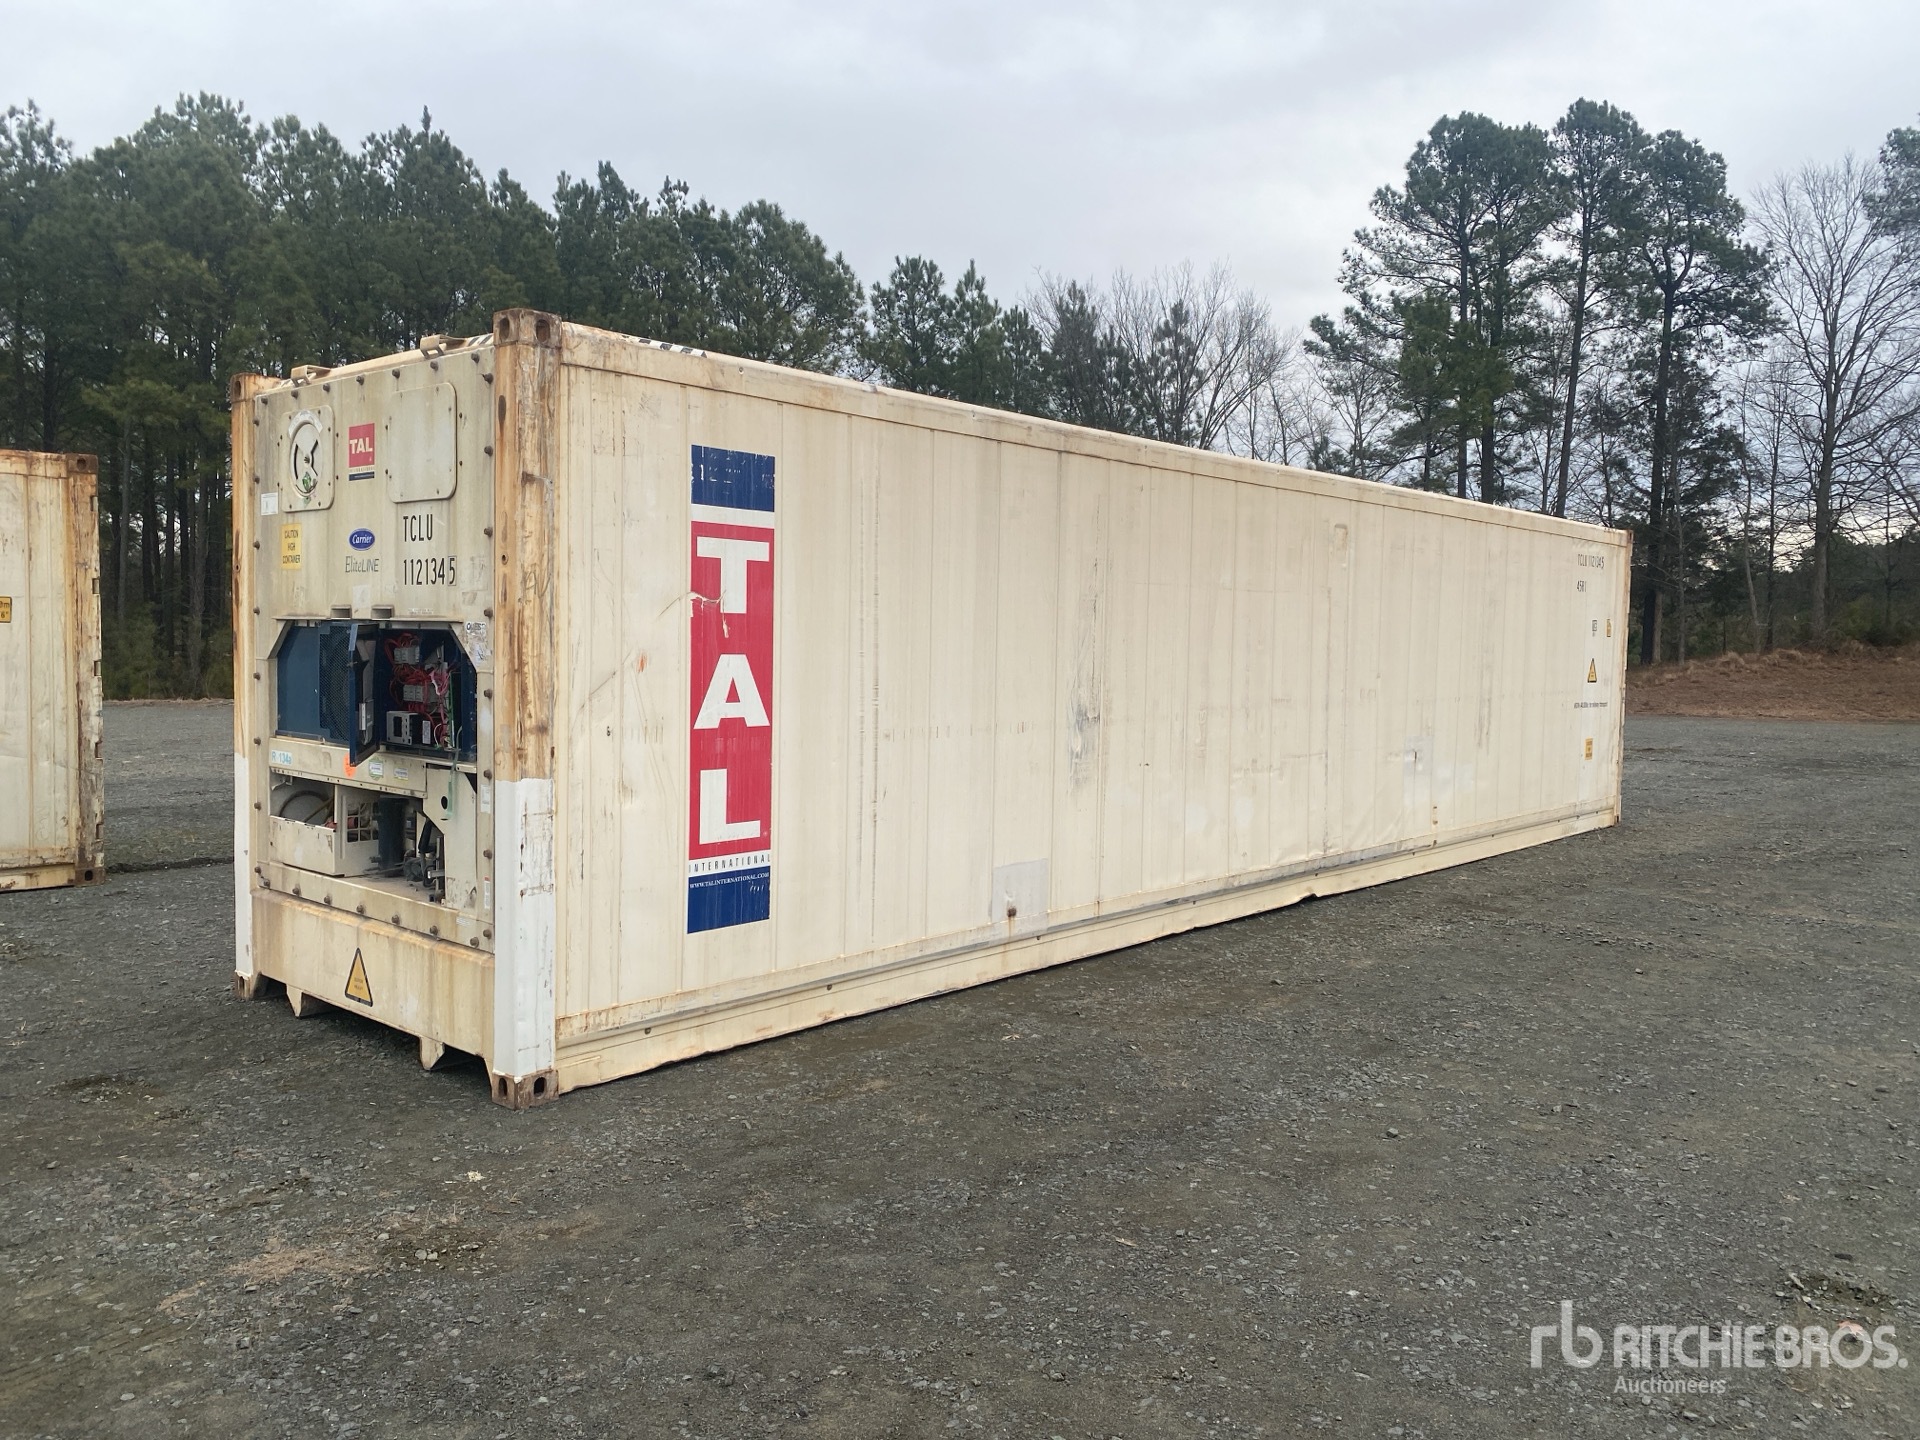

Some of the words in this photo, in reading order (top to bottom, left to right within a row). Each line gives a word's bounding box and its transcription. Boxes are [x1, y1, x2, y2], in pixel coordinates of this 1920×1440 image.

[349, 437, 373, 454] TAL
[403, 513, 433, 542] TCLU
[352, 534, 372, 544] Carrier
[693, 536, 771, 845] TAL
[688, 853, 771, 873] INTERNATIONAL
